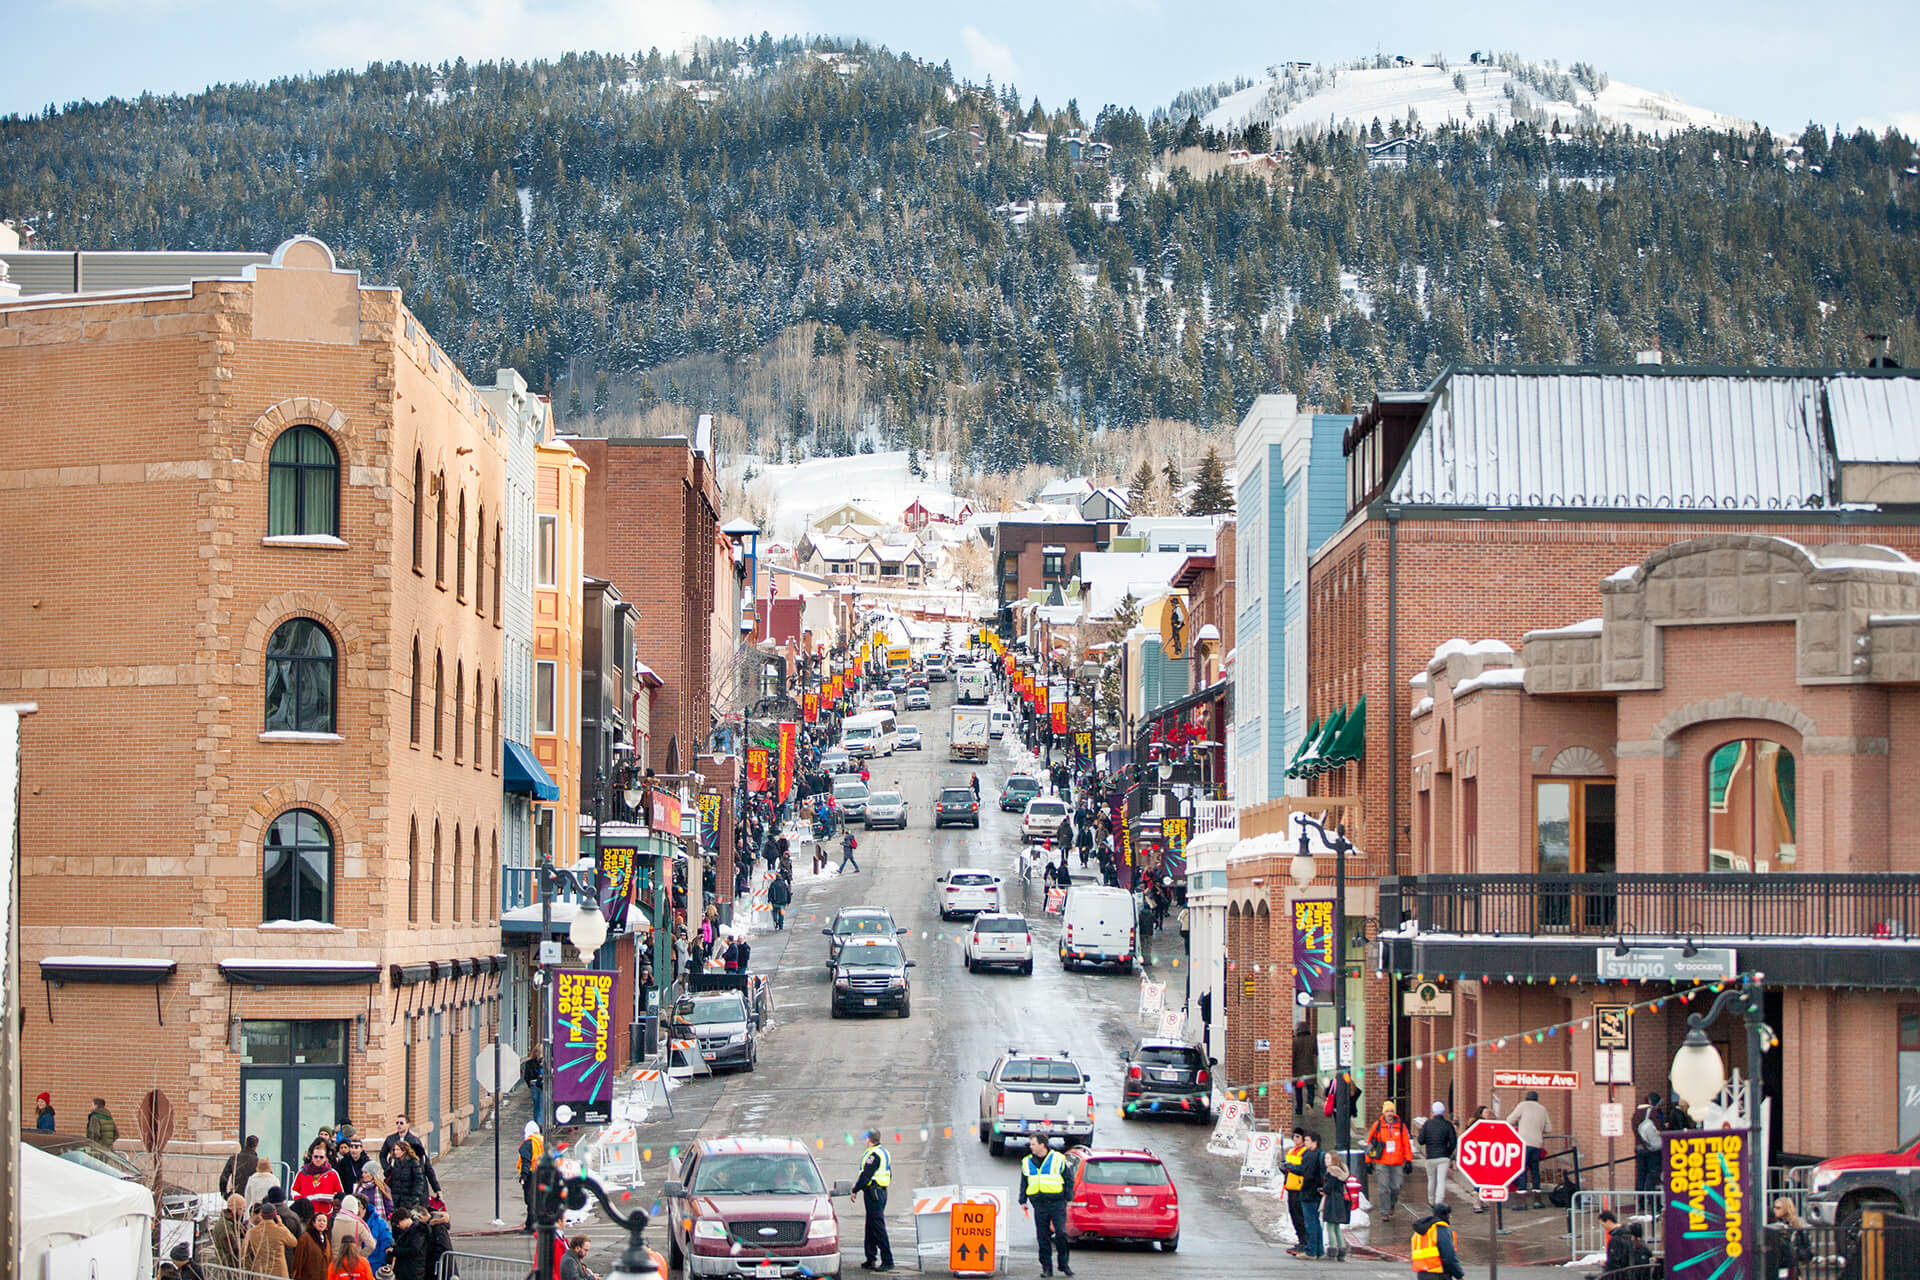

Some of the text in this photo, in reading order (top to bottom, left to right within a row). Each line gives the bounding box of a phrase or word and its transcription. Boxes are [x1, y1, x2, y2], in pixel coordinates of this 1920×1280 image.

[604, 848, 612, 870] 2016
[610, 848, 619, 887] Festival
[618, 848, 626, 868] Film
[620, 848, 634, 897] Sundance
[1296, 902, 1305, 930] 2016
[1305, 902, 1316, 950] Festival
[1314, 902, 1322, 927] Film
[1323, 902, 1333, 963] Sundance
[1606, 962, 1665, 977] STUDIO
[558, 973, 573, 1014] 2016
[570, 974, 586, 1042] Festival
[584, 975, 598, 1011] Film
[595, 975, 612, 1062] Sundance
[252, 1093, 273, 1102] SKY
[1517, 1074, 1550, 1086] Heber
[1552, 1074, 1576, 1086] Ave.
[1462, 1140, 1521, 1168] STOP
[1670, 1138, 1688, 1194] 2016
[1705, 1136, 1723, 1187] Film
[1688, 1138, 1708, 1231] Festival
[1723, 1135, 1744, 1258] Sundance
[955, 1228, 992, 1236] TURNS
[964, 1213, 984, 1223] NO
